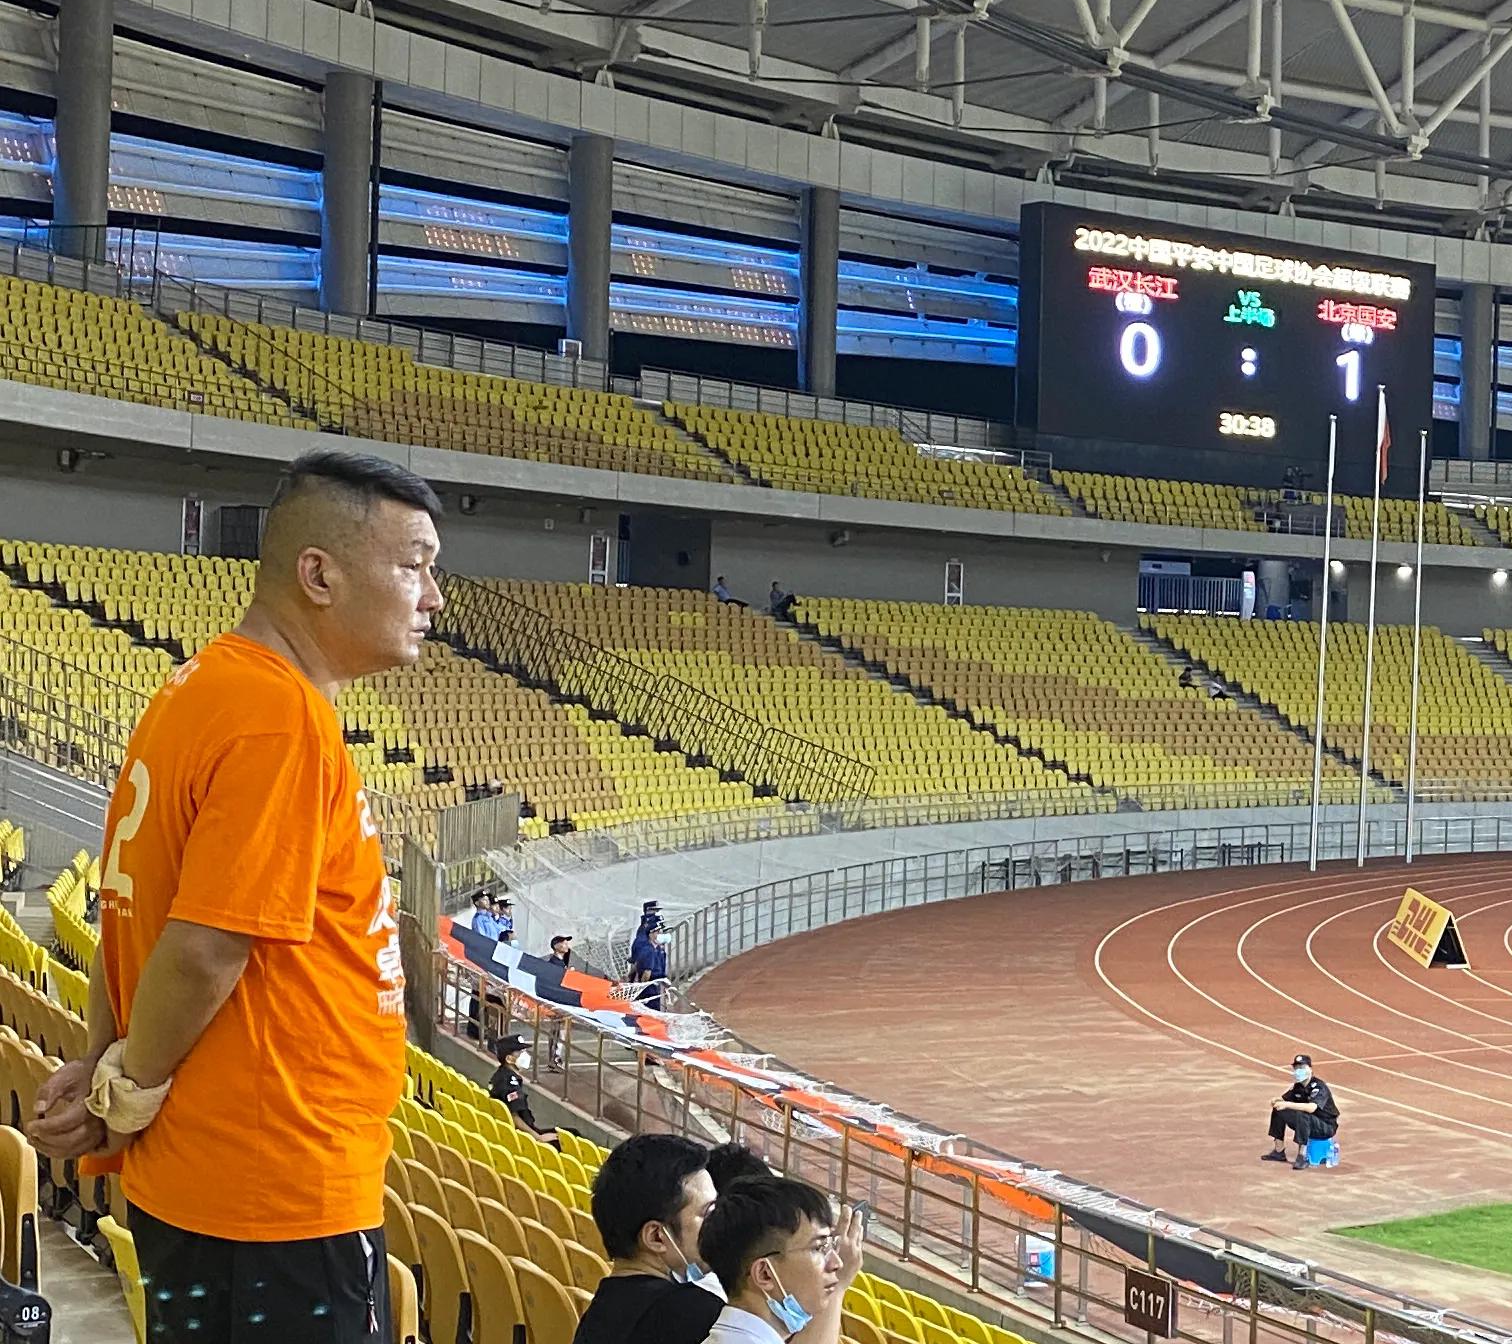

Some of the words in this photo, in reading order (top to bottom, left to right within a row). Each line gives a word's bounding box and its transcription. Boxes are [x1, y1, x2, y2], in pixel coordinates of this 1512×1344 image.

[1088, 266, 1179, 300] 武汉长江
[1237, 289, 1262, 308] VS
[1317, 299, 1398, 330] 北京国安
[1119, 322, 1161, 377] 0
[1335, 349, 1361, 402] 1
[1218, 412, 1277, 439] 30:38
[21, 1306, 40, 1321] 08
[1129, 1286, 1166, 1320] C117
